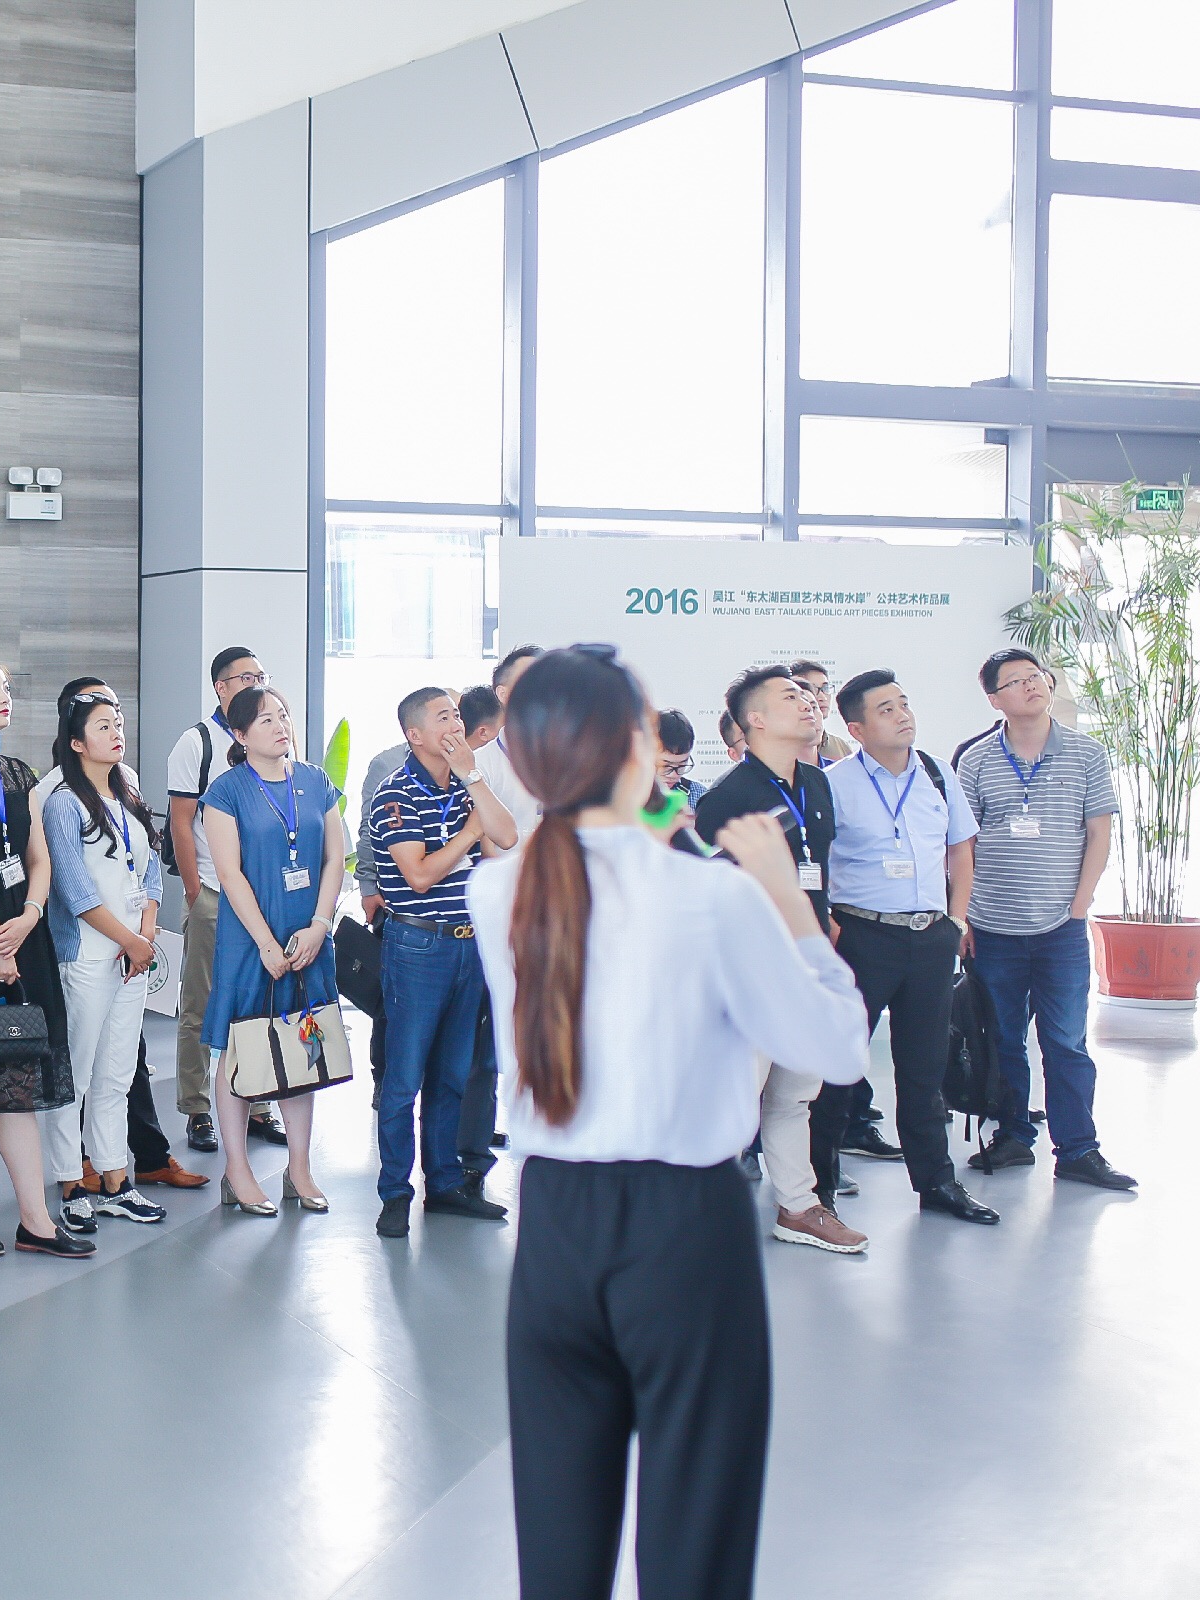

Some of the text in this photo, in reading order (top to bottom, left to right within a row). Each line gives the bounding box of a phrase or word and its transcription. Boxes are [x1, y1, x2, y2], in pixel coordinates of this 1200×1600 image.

[625, 587, 699, 615] 2016
[712, 607, 751, 616] WUJIANG
[754, 607, 776, 616] EAST
[778, 607, 812, 616] TAILAKE
[813, 608, 842, 616] PUBLIC
[843, 608, 861, 617] ART
[861, 608, 889, 617] PIECES
